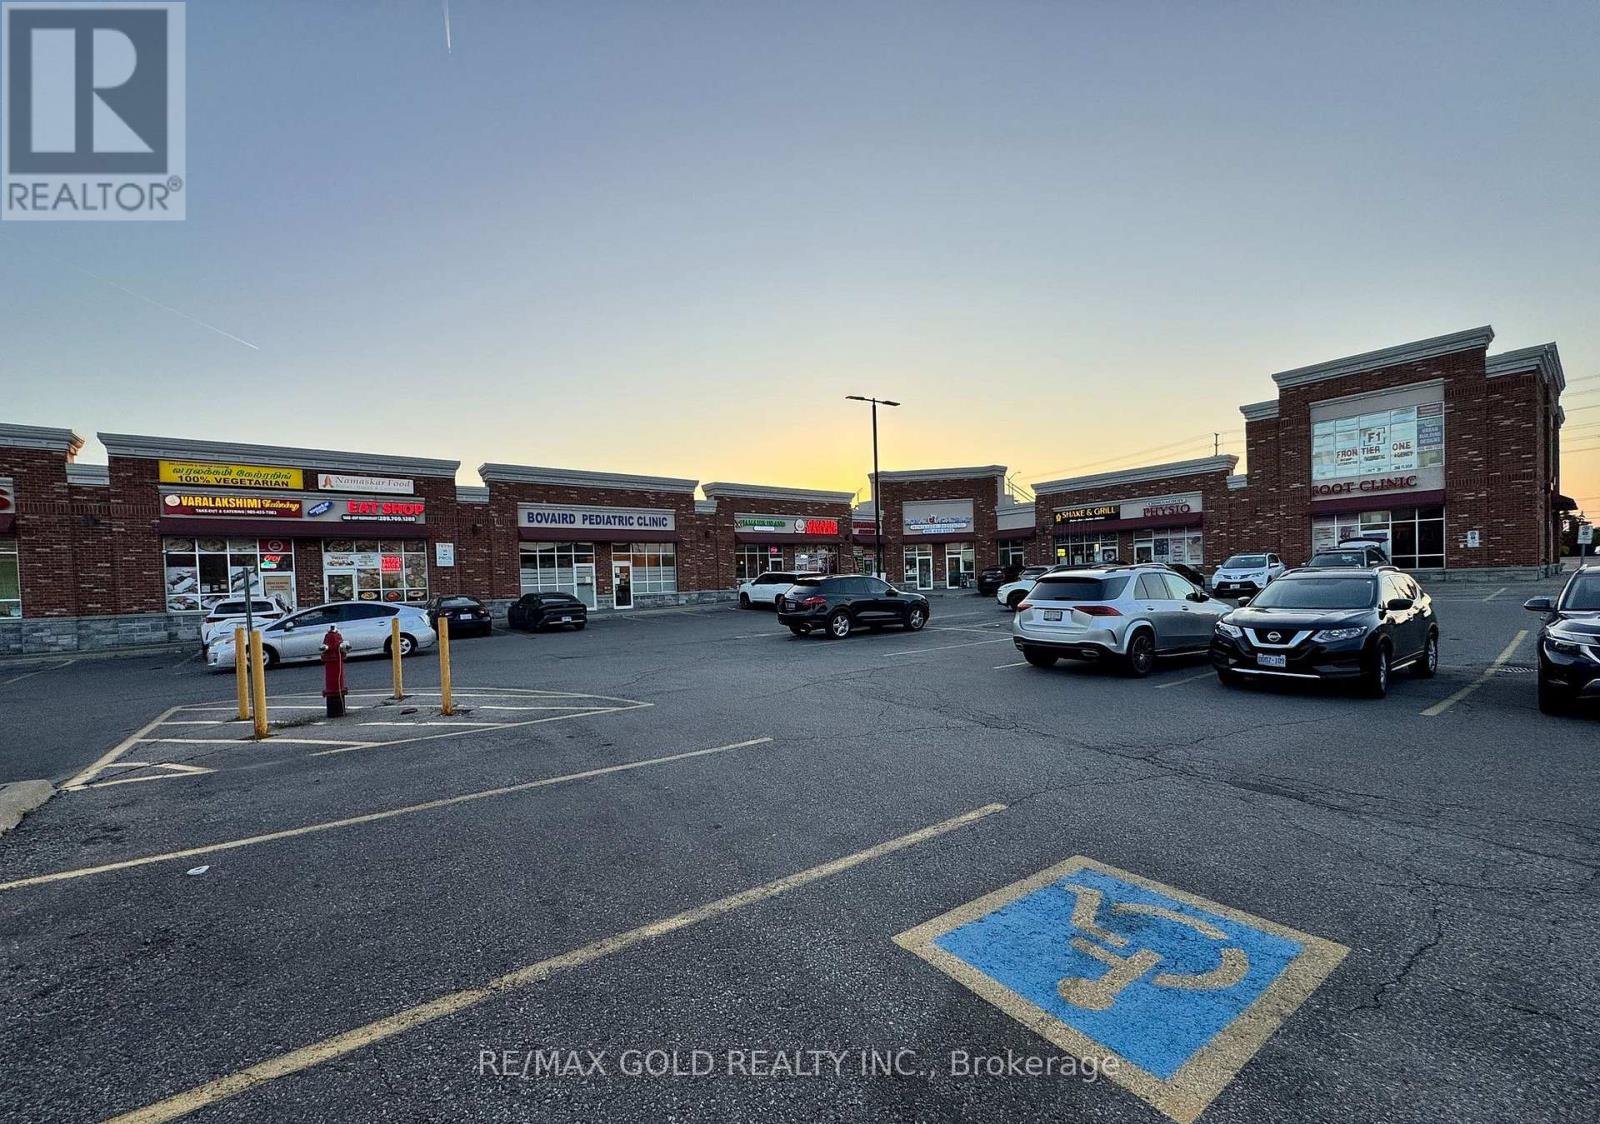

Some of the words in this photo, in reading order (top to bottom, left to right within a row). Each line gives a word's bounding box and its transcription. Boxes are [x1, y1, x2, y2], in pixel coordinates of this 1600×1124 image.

[1367, 431, 1381, 443] F1
[1392, 441, 1411, 451] ONE
[178, 475, 211, 484] 100%
[214, 476, 289, 488] VEGETARIAN
[335, 476, 385, 487] Namaskar
[388, 479, 411, 488] Food
[1359, 475, 1417, 492] CLINIC
[347, 499, 379, 514] EAT
[382, 501, 425, 517] SHOP
[1062, 509, 1085, 520] SHAKE
[1086, 508, 1093, 516] &
[1093, 506, 1116, 516] GRILL
[1143, 503, 1191, 517] PHYSIO
[527, 511, 576, 525] BOVAIRD
[582, 513, 635, 527] PEDIATRIC
[637, 515, 668, 528] CLINIC
